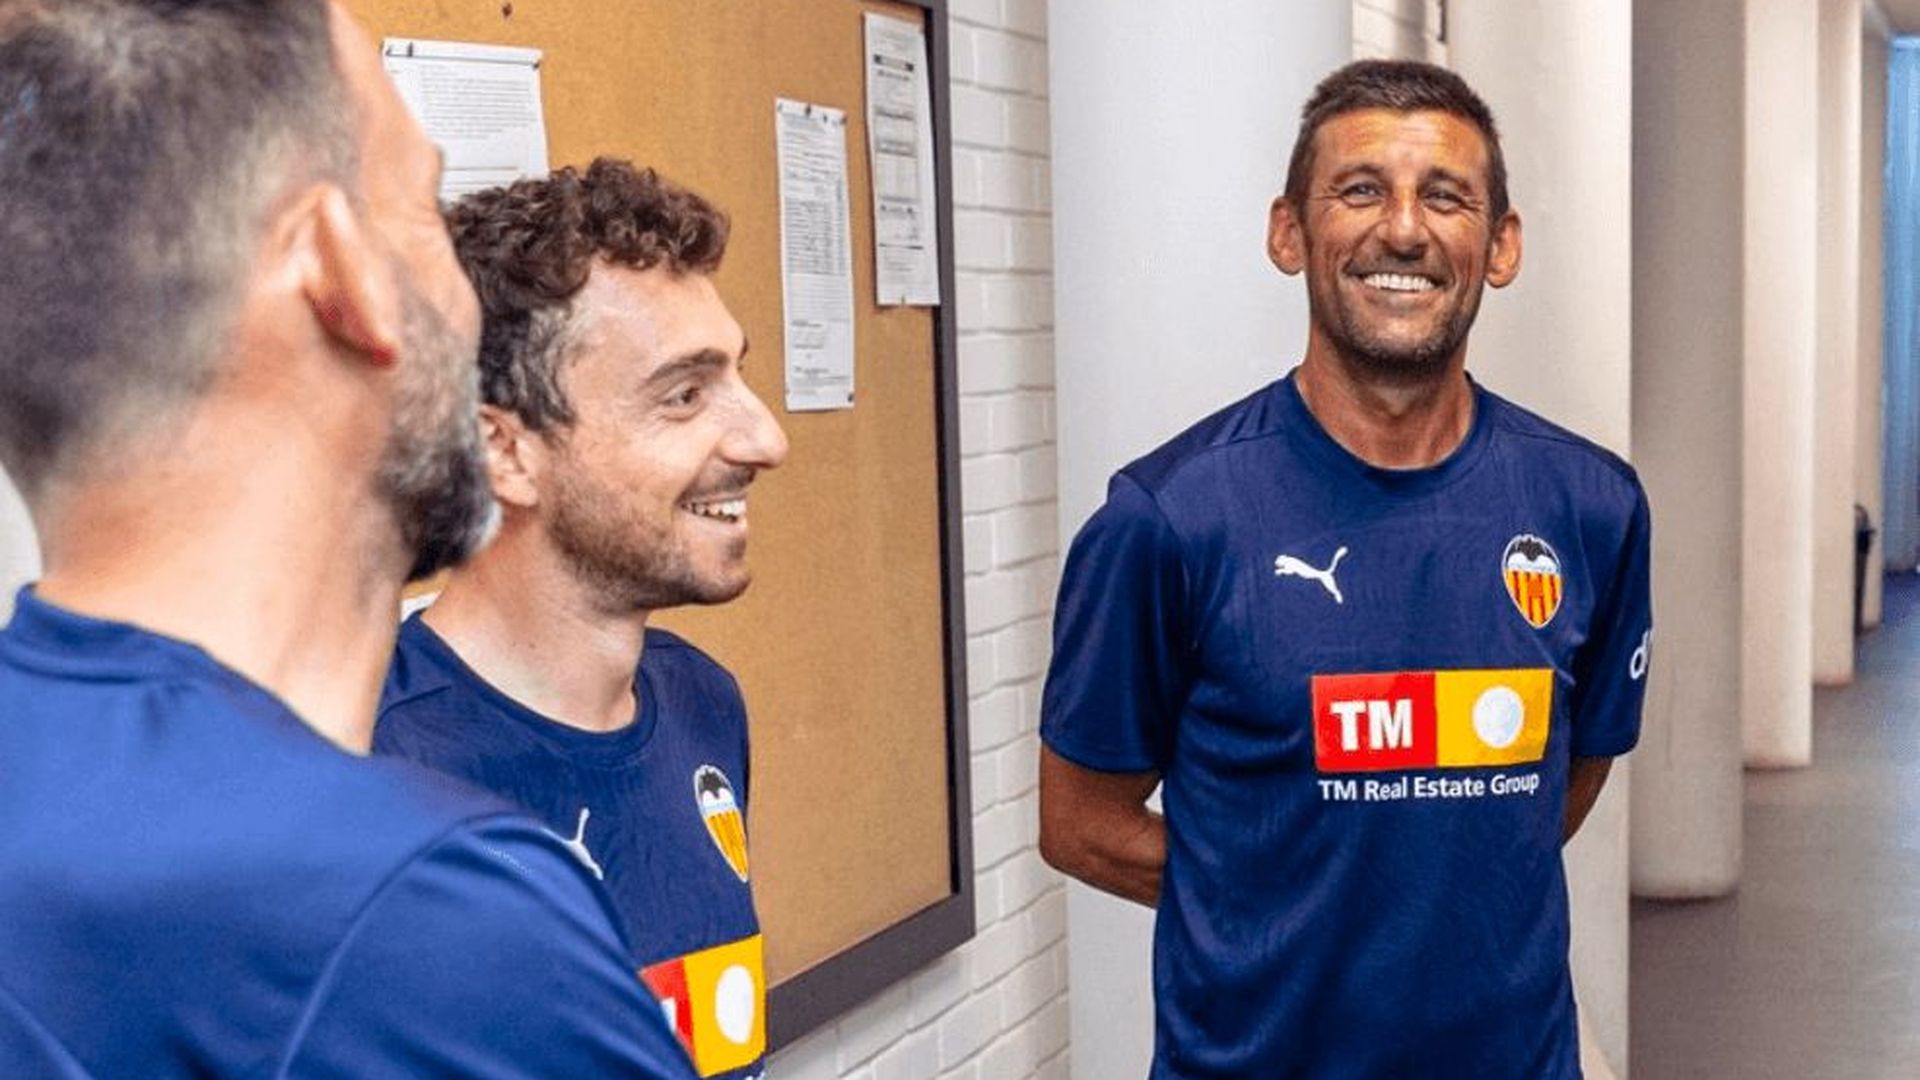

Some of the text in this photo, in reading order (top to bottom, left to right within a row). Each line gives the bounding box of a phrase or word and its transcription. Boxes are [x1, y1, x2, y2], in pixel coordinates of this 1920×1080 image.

[1330, 698, 1413, 752] TM
[1318, 773, 1540, 801] TM Real Estate Group
